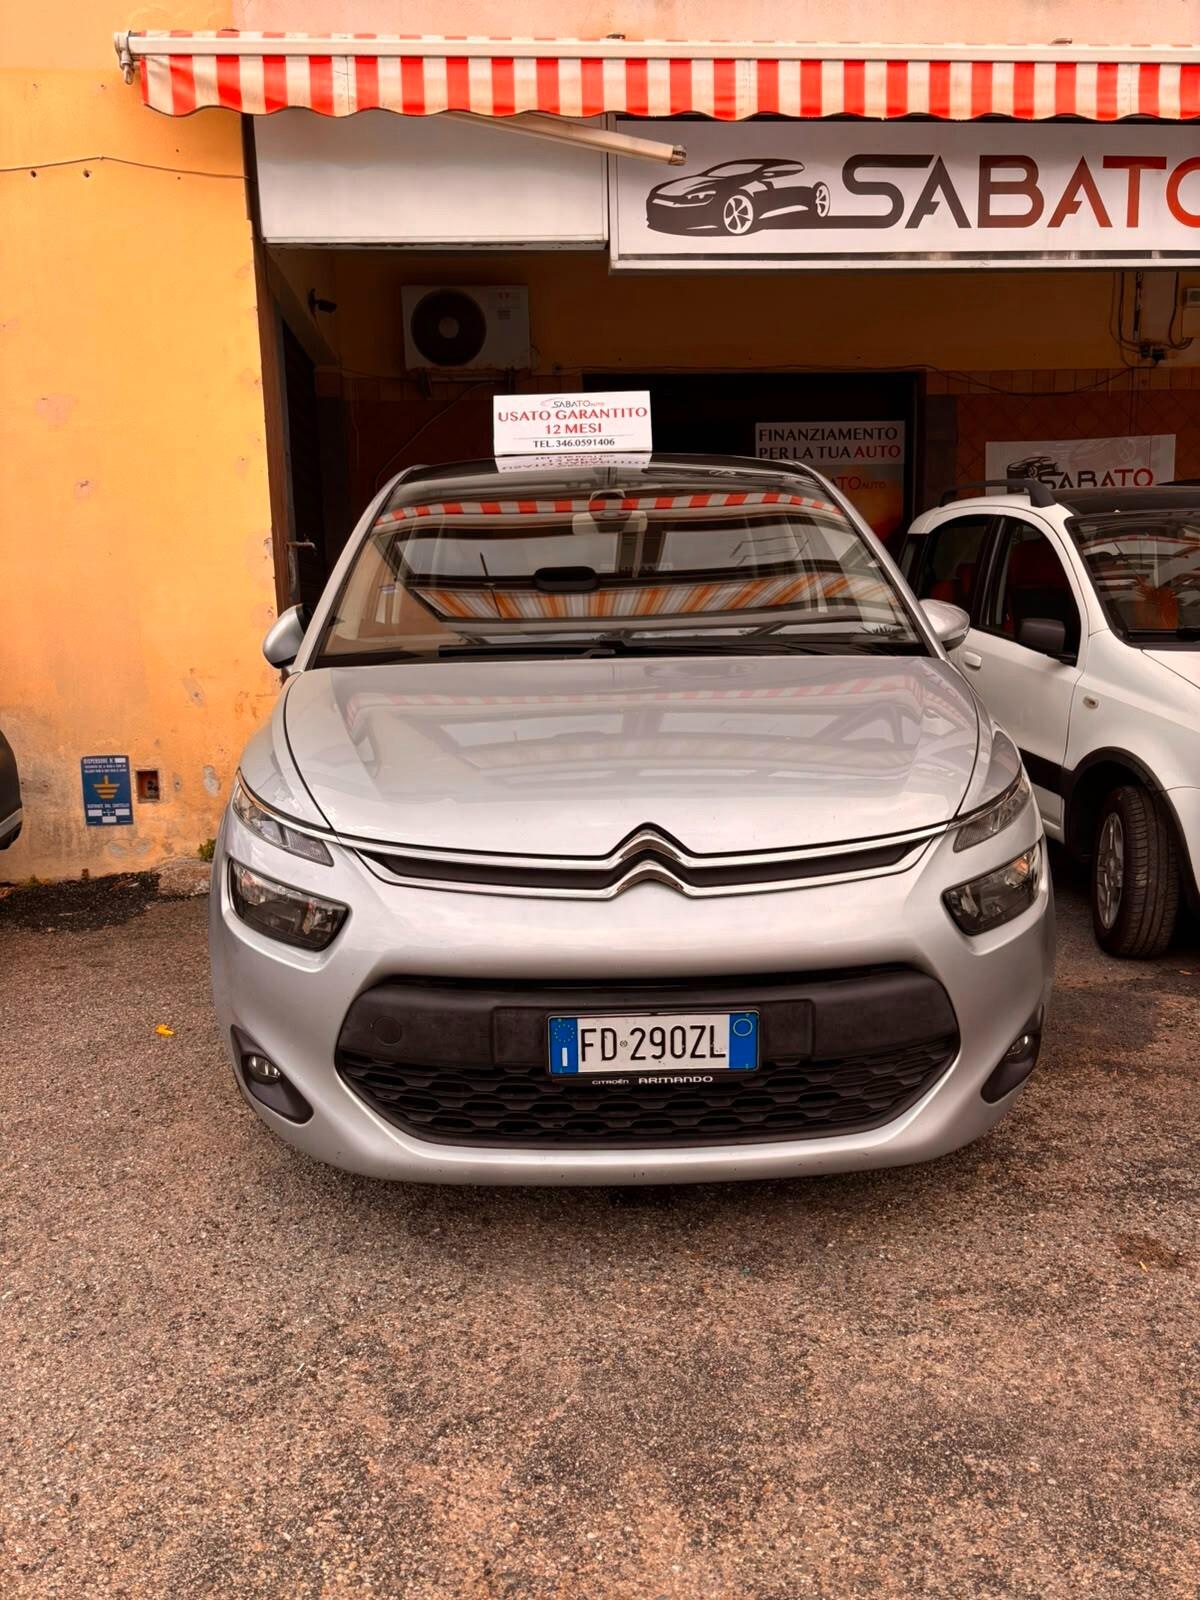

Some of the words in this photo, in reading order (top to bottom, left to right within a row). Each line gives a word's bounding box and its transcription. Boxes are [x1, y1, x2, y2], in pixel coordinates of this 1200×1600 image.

[498, 410, 551, 422] USATO
[555, 407, 648, 420] GARANTITO
[545, 424, 561, 435] 12
[565, 423, 603, 434] MESI
[759, 427, 898, 442] FINANZIAMENTO
[759, 447, 790, 459] PER
[793, 446, 814, 459] LA
[816, 446, 851, 459] TUA
[854, 445, 901, 458] AUTO
[638, 1075, 714, 1085] ARMANDO
